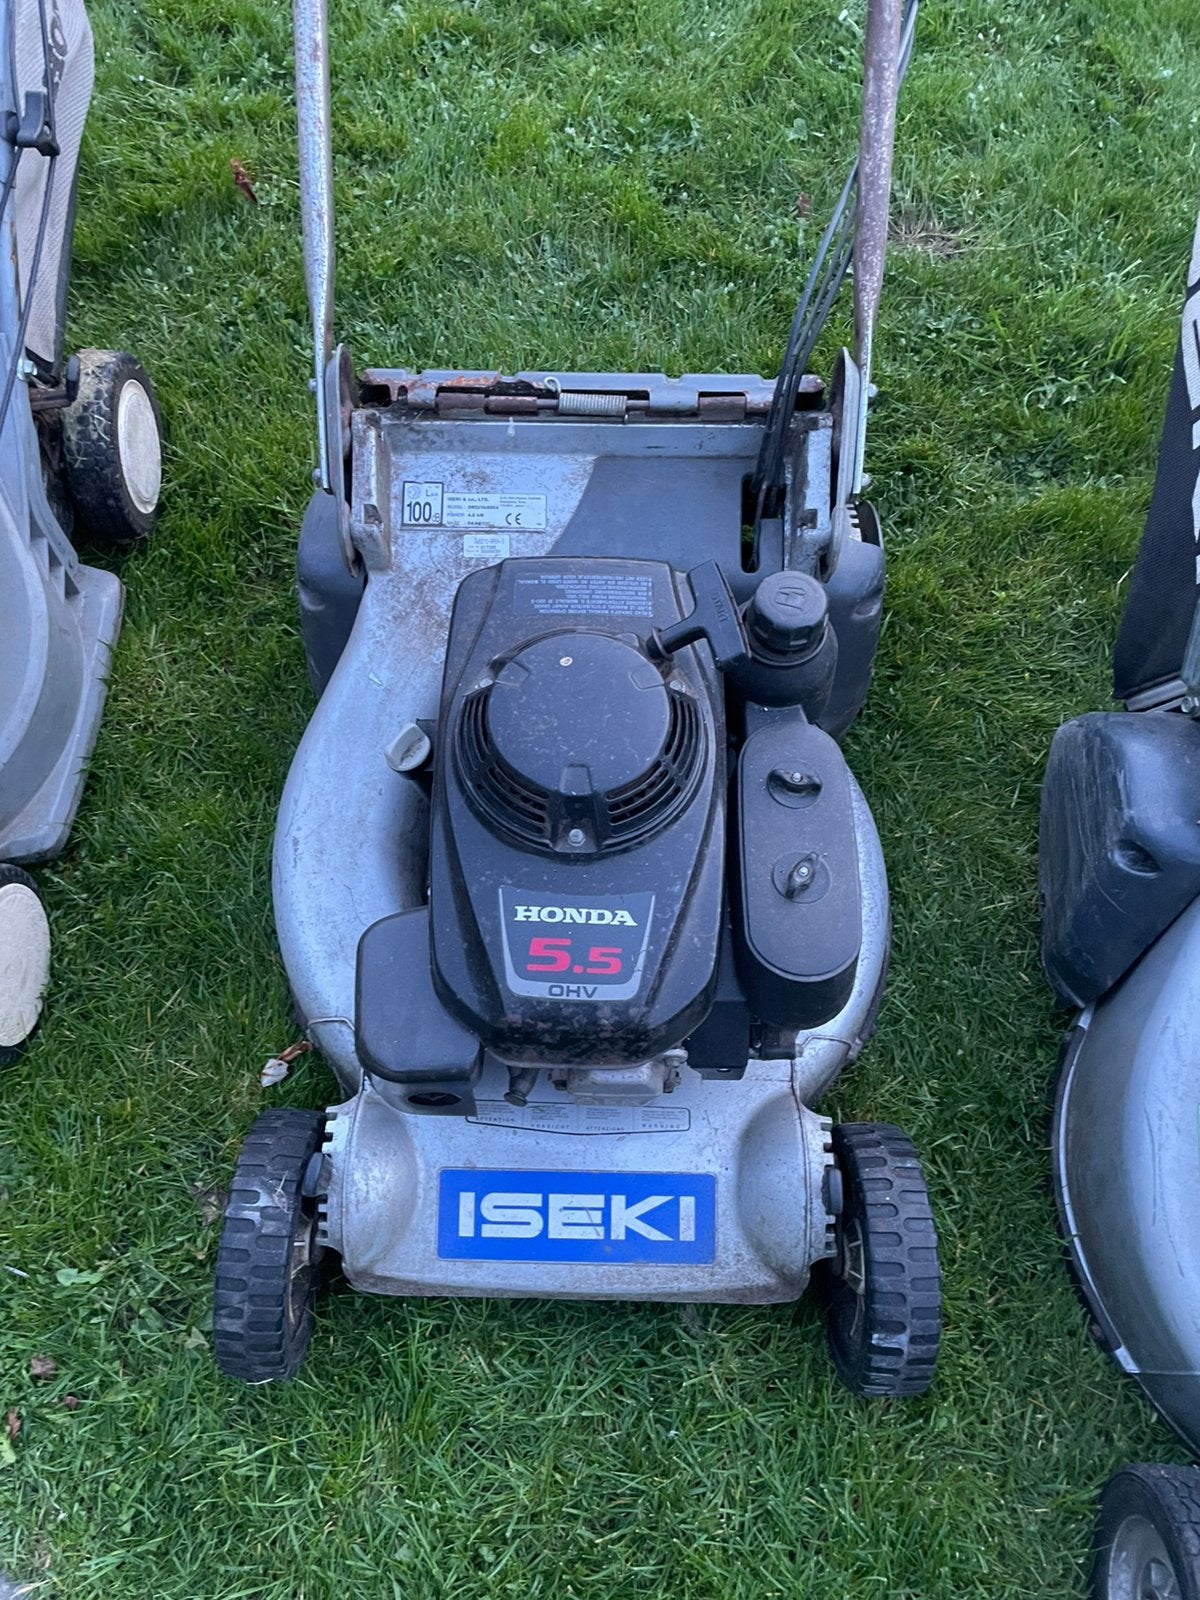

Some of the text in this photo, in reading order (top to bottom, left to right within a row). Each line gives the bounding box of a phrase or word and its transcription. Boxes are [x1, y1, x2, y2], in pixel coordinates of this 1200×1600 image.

[406, 501, 432, 522] 100
[514, 905, 638, 926] HONDA
[526, 937, 623, 974] 5.5
[548, 984, 598, 998] OHV
[458, 1191, 695, 1242] ISEKI
